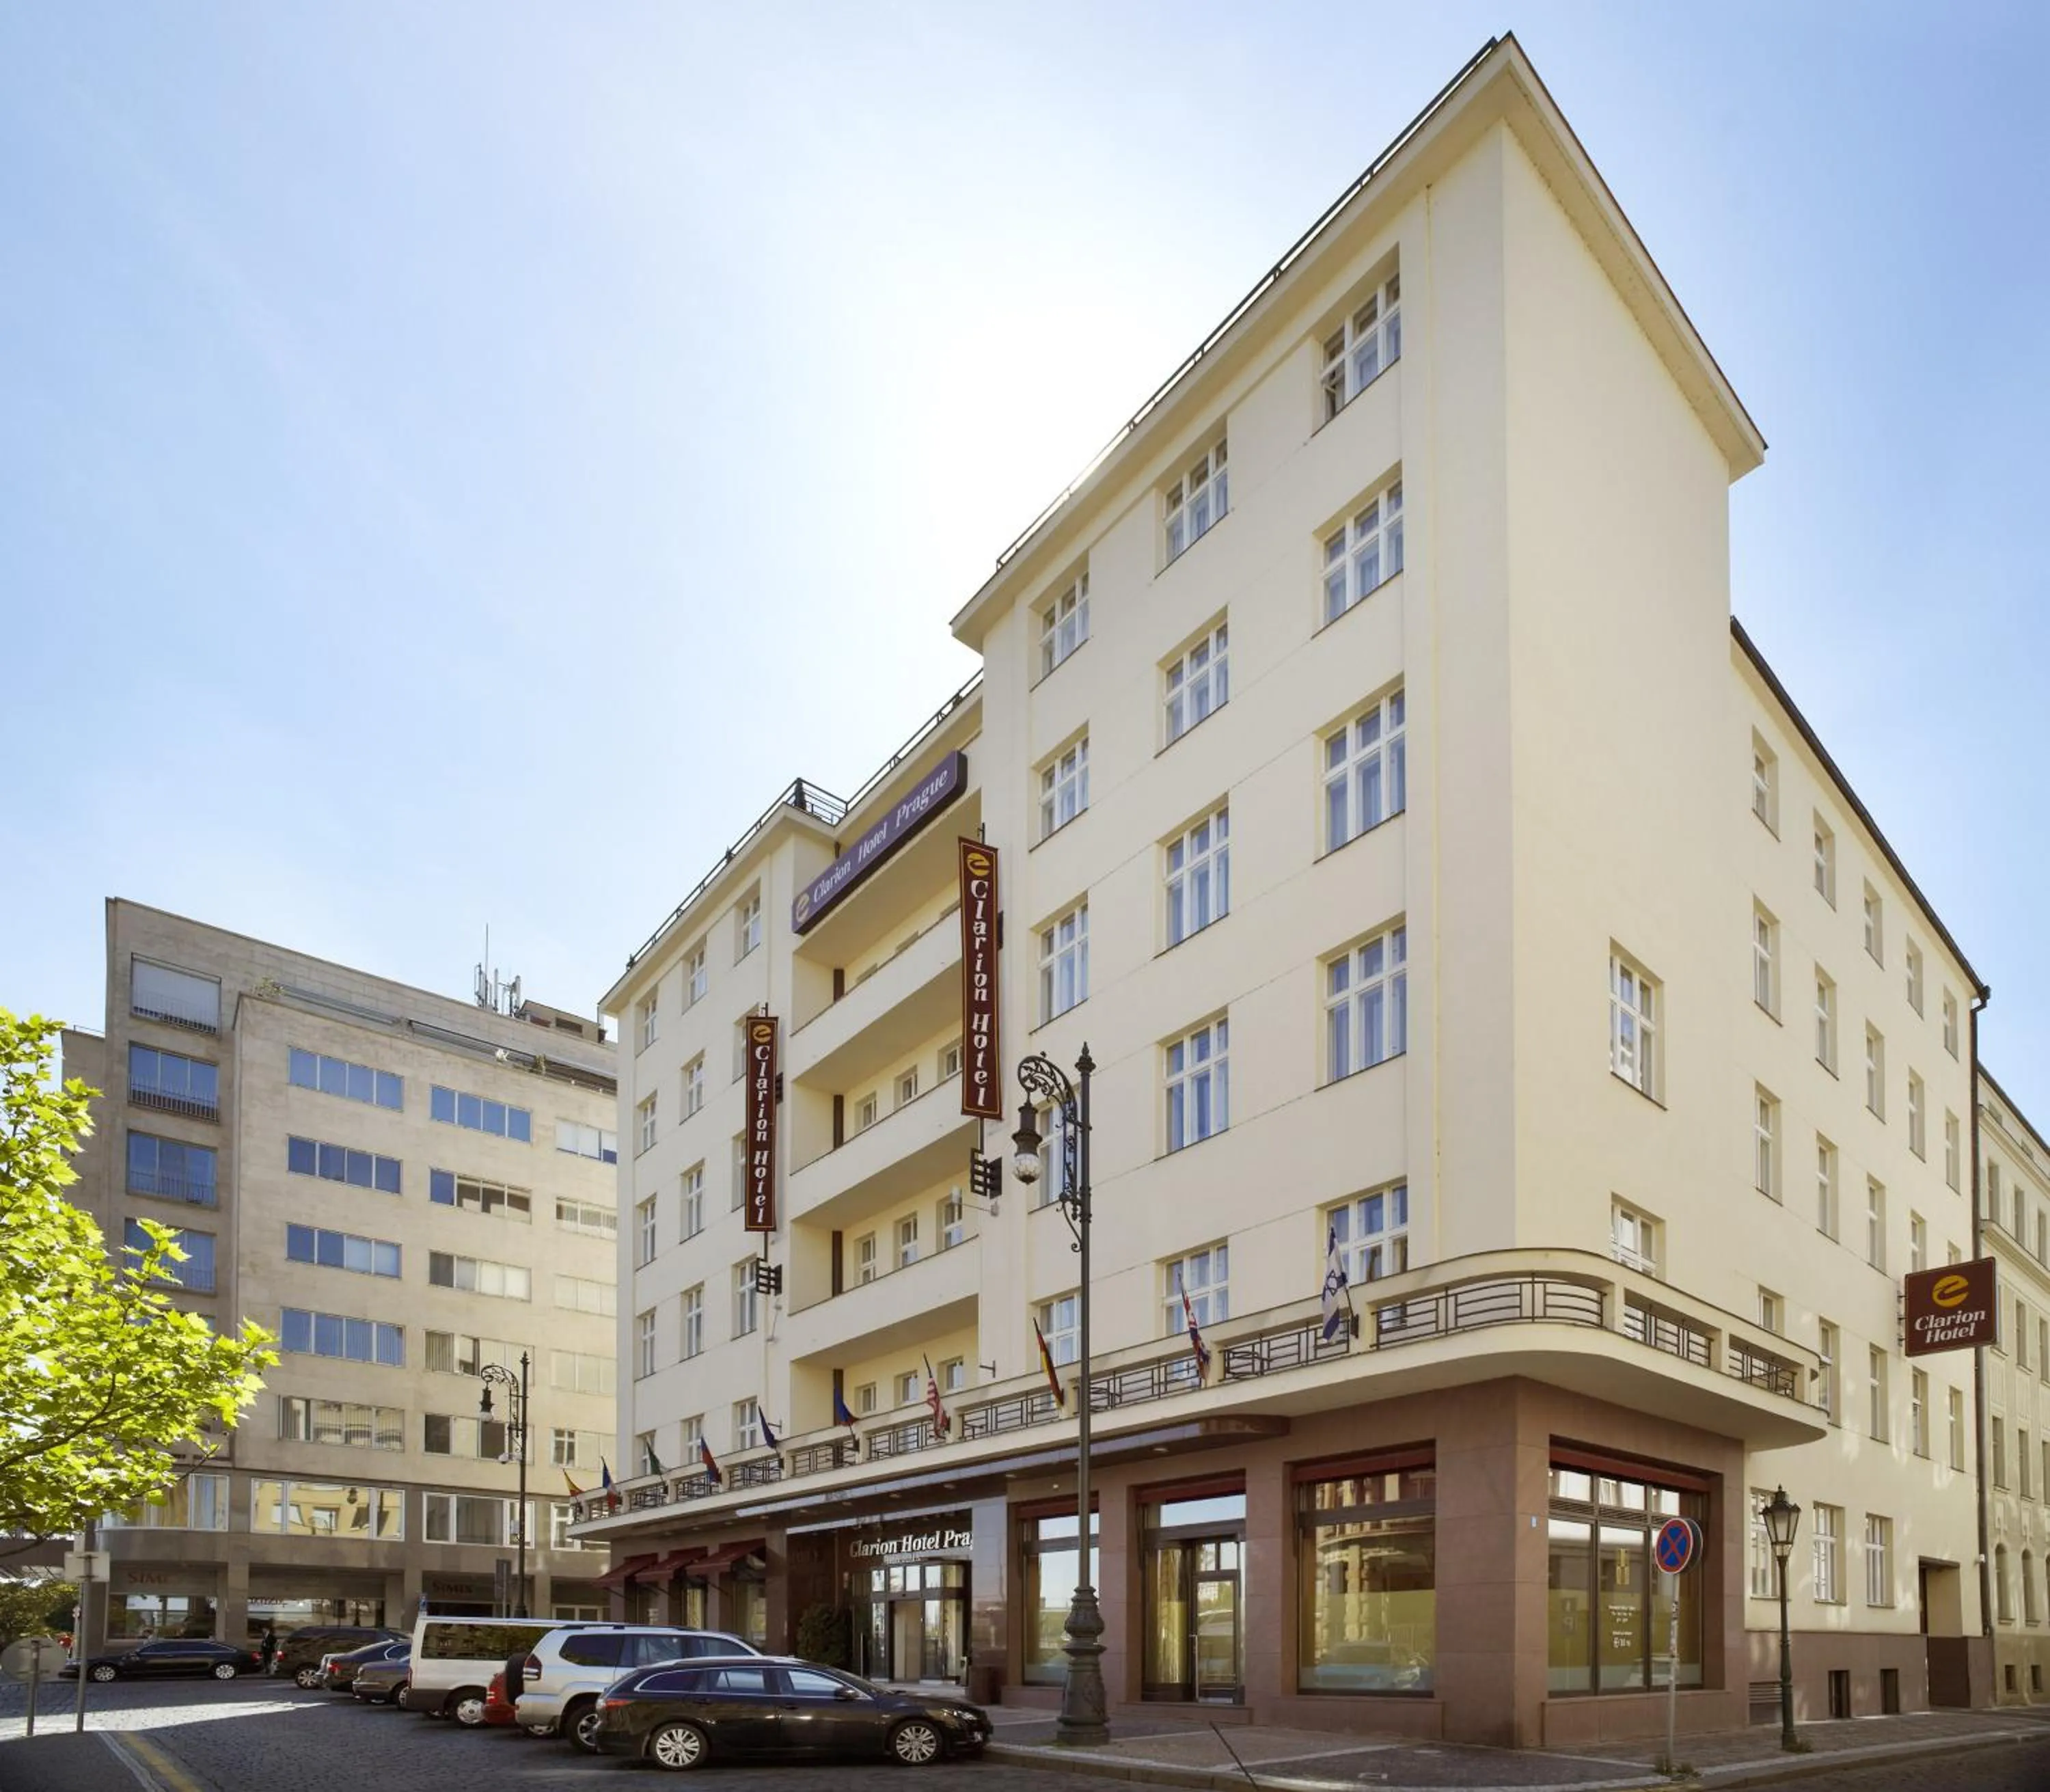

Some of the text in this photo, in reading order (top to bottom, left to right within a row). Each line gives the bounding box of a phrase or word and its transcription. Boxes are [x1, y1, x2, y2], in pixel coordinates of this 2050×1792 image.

[813, 768, 948, 903] Clarion Hotel Prague
[970, 879, 992, 1107] Clarion Hotel
[754, 1045, 770, 1223] Clarion Hotel
[1914, 1309, 1986, 1331] Clarion
[1924, 1323, 1976, 1344] Hotel
[849, 1537, 898, 1558] Clarion
[901, 1530, 941, 1553] Hotel
[944, 1528, 974, 1550] Pra
